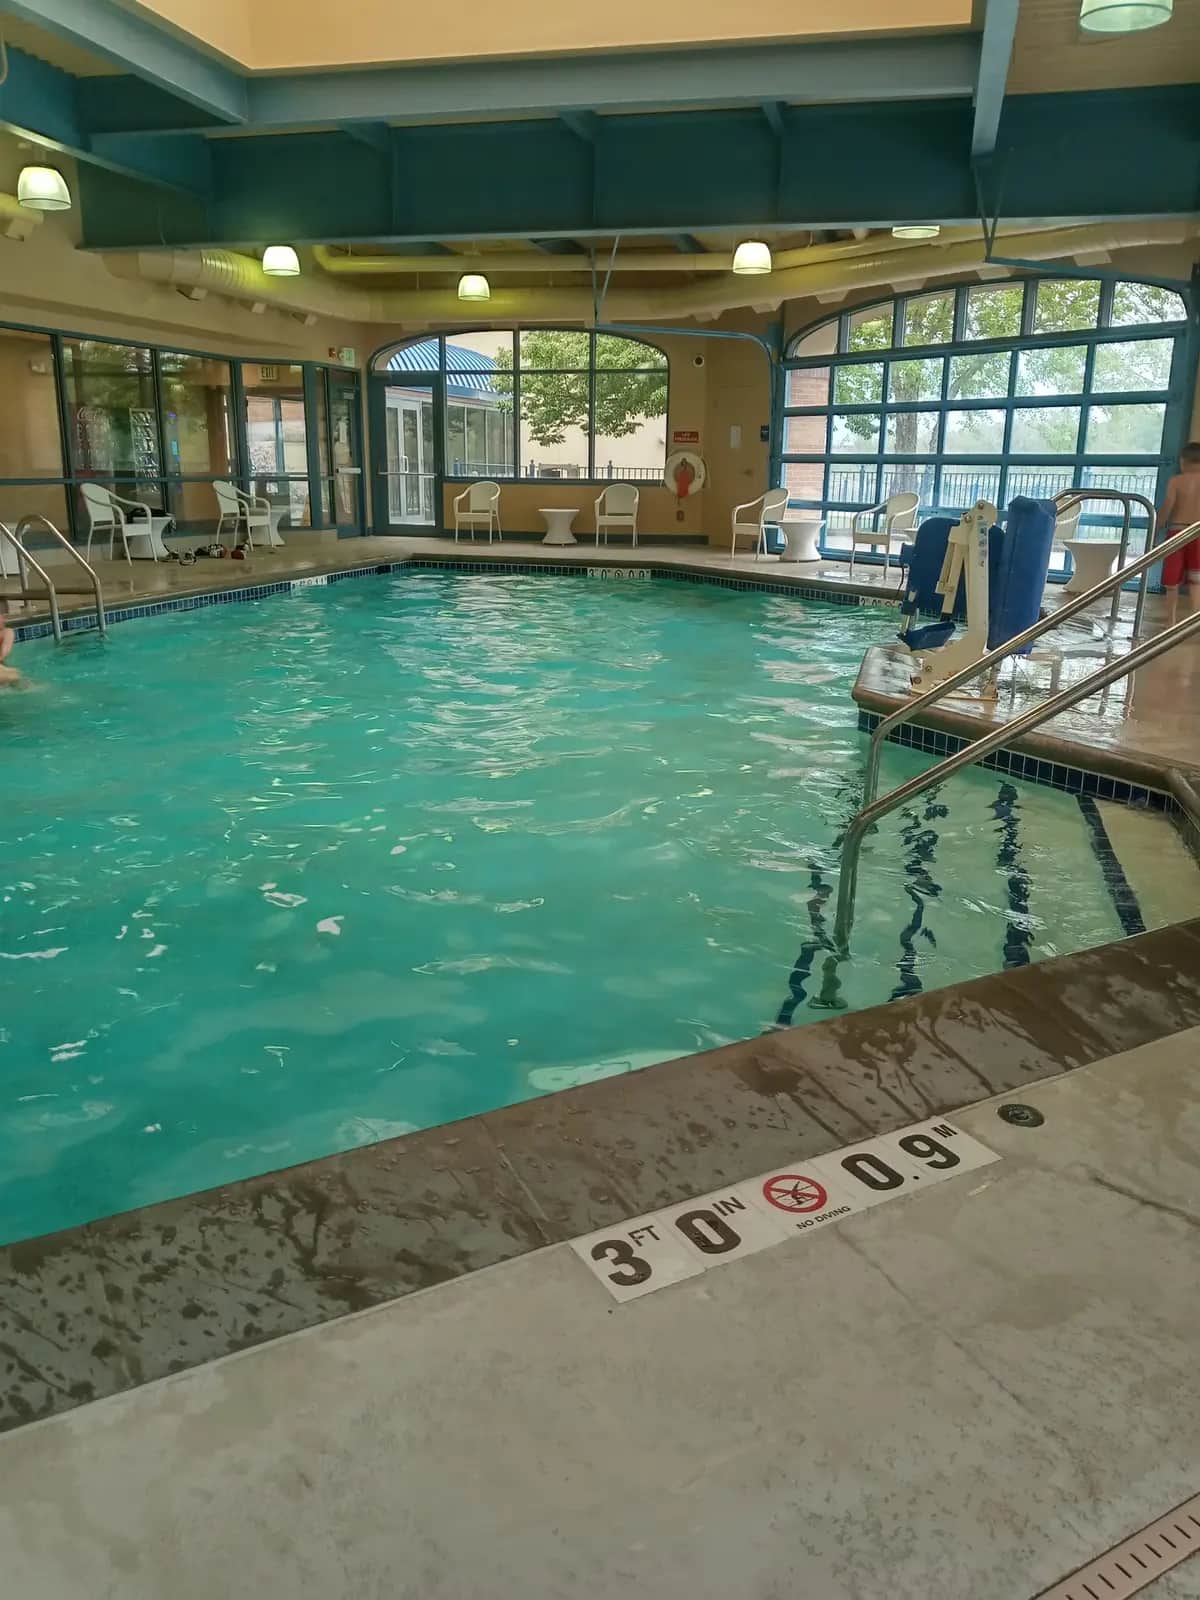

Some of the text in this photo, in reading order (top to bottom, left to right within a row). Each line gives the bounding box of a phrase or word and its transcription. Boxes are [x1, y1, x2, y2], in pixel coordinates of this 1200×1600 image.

[261, 367, 275, 378] EXIT
[796, 1205, 851, 1230] NO DIVING
